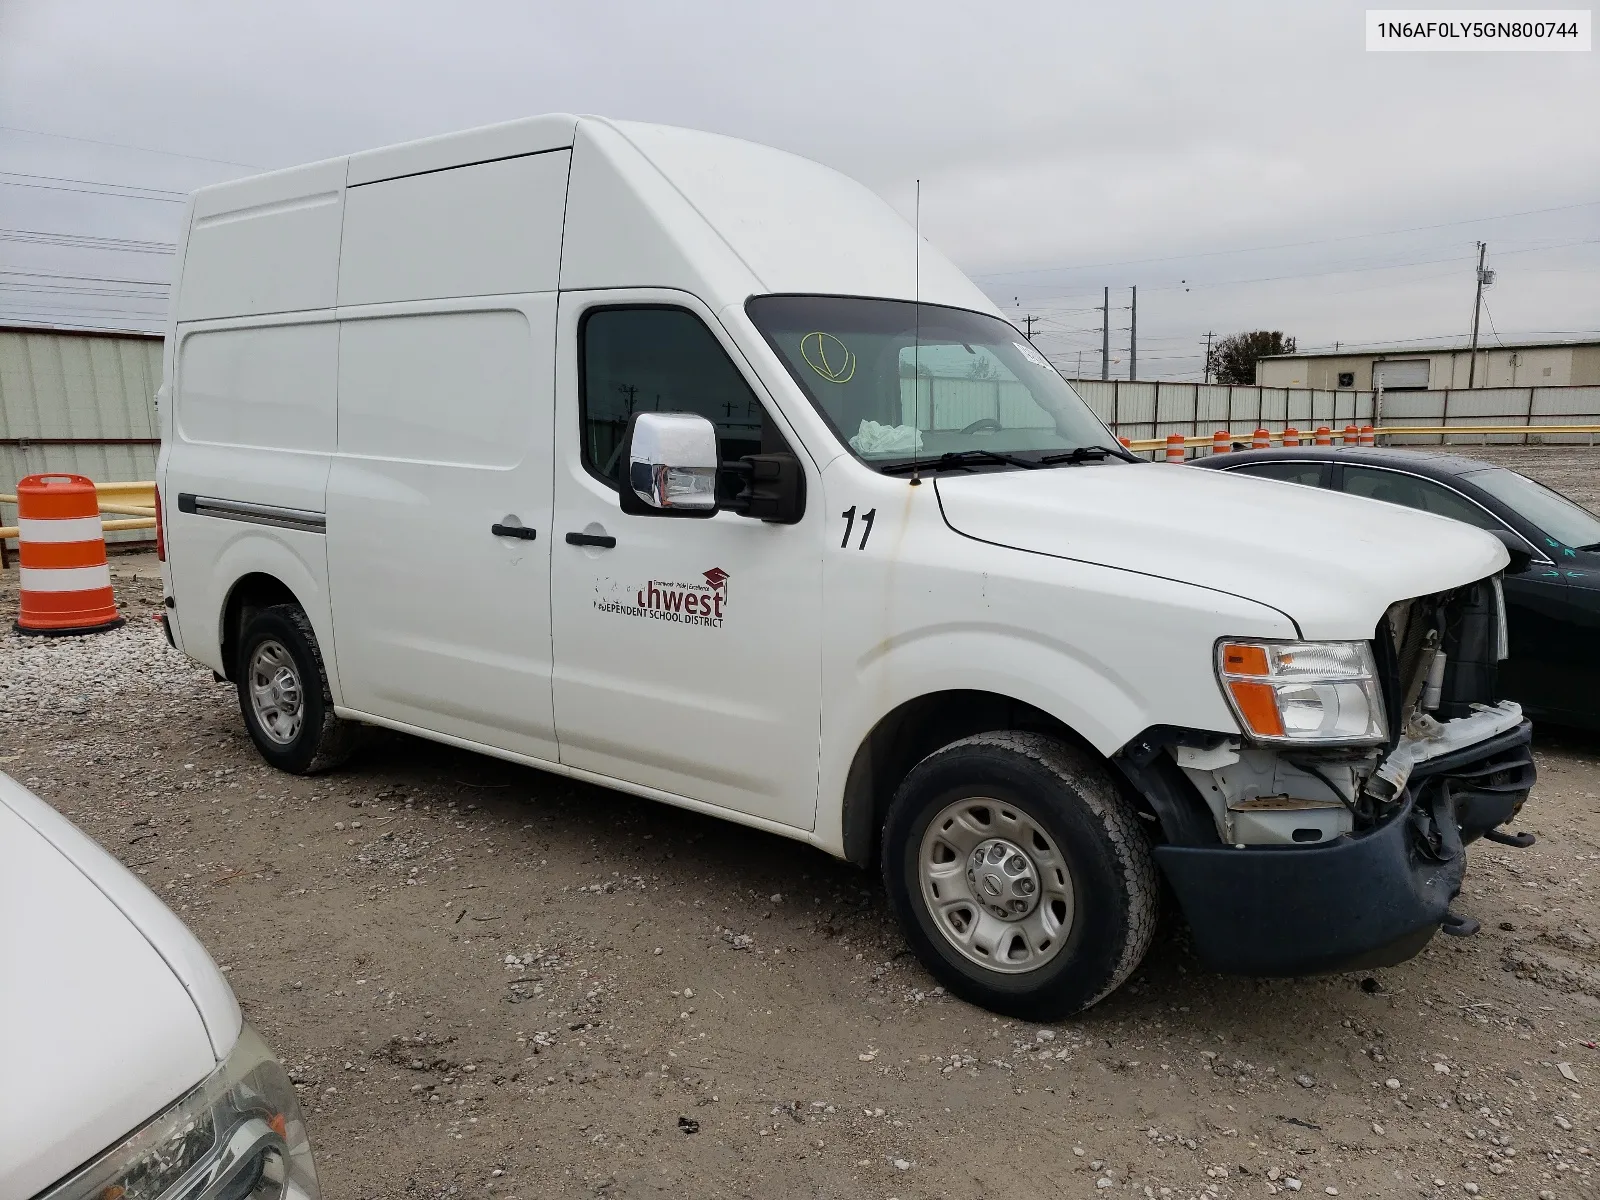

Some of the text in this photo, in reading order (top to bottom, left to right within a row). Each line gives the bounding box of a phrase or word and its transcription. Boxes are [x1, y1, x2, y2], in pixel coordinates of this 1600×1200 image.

[840, 505, 877, 551] 11
[649, 609, 683, 623] SCHOOL
[684, 614, 724, 628] DISTRICT
